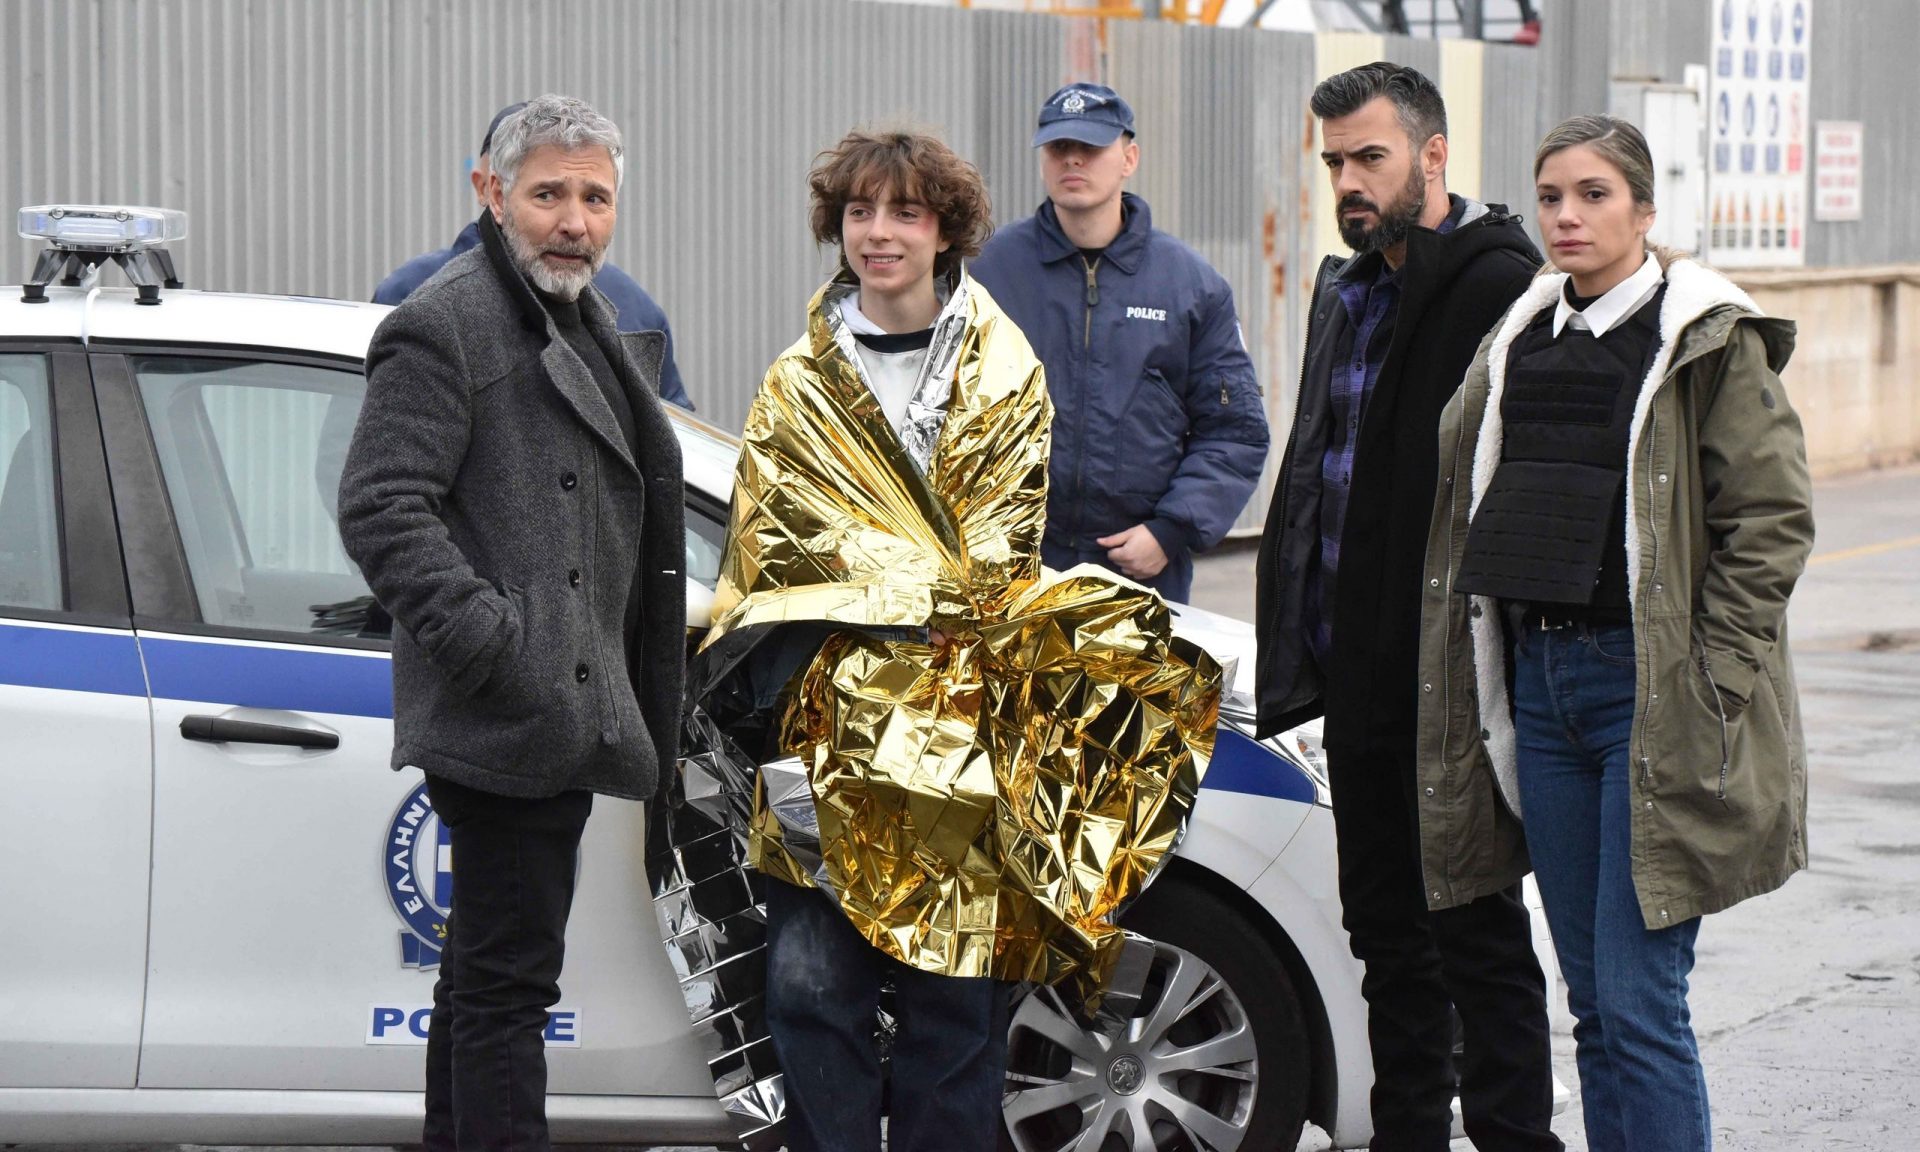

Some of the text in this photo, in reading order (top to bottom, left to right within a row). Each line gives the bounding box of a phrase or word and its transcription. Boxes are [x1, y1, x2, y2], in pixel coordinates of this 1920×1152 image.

[1126, 307, 1166, 321] POLICE
[393, 793, 431, 915] ΕΛΛΗΝΙ
[373, 1008, 575, 1041] POE
